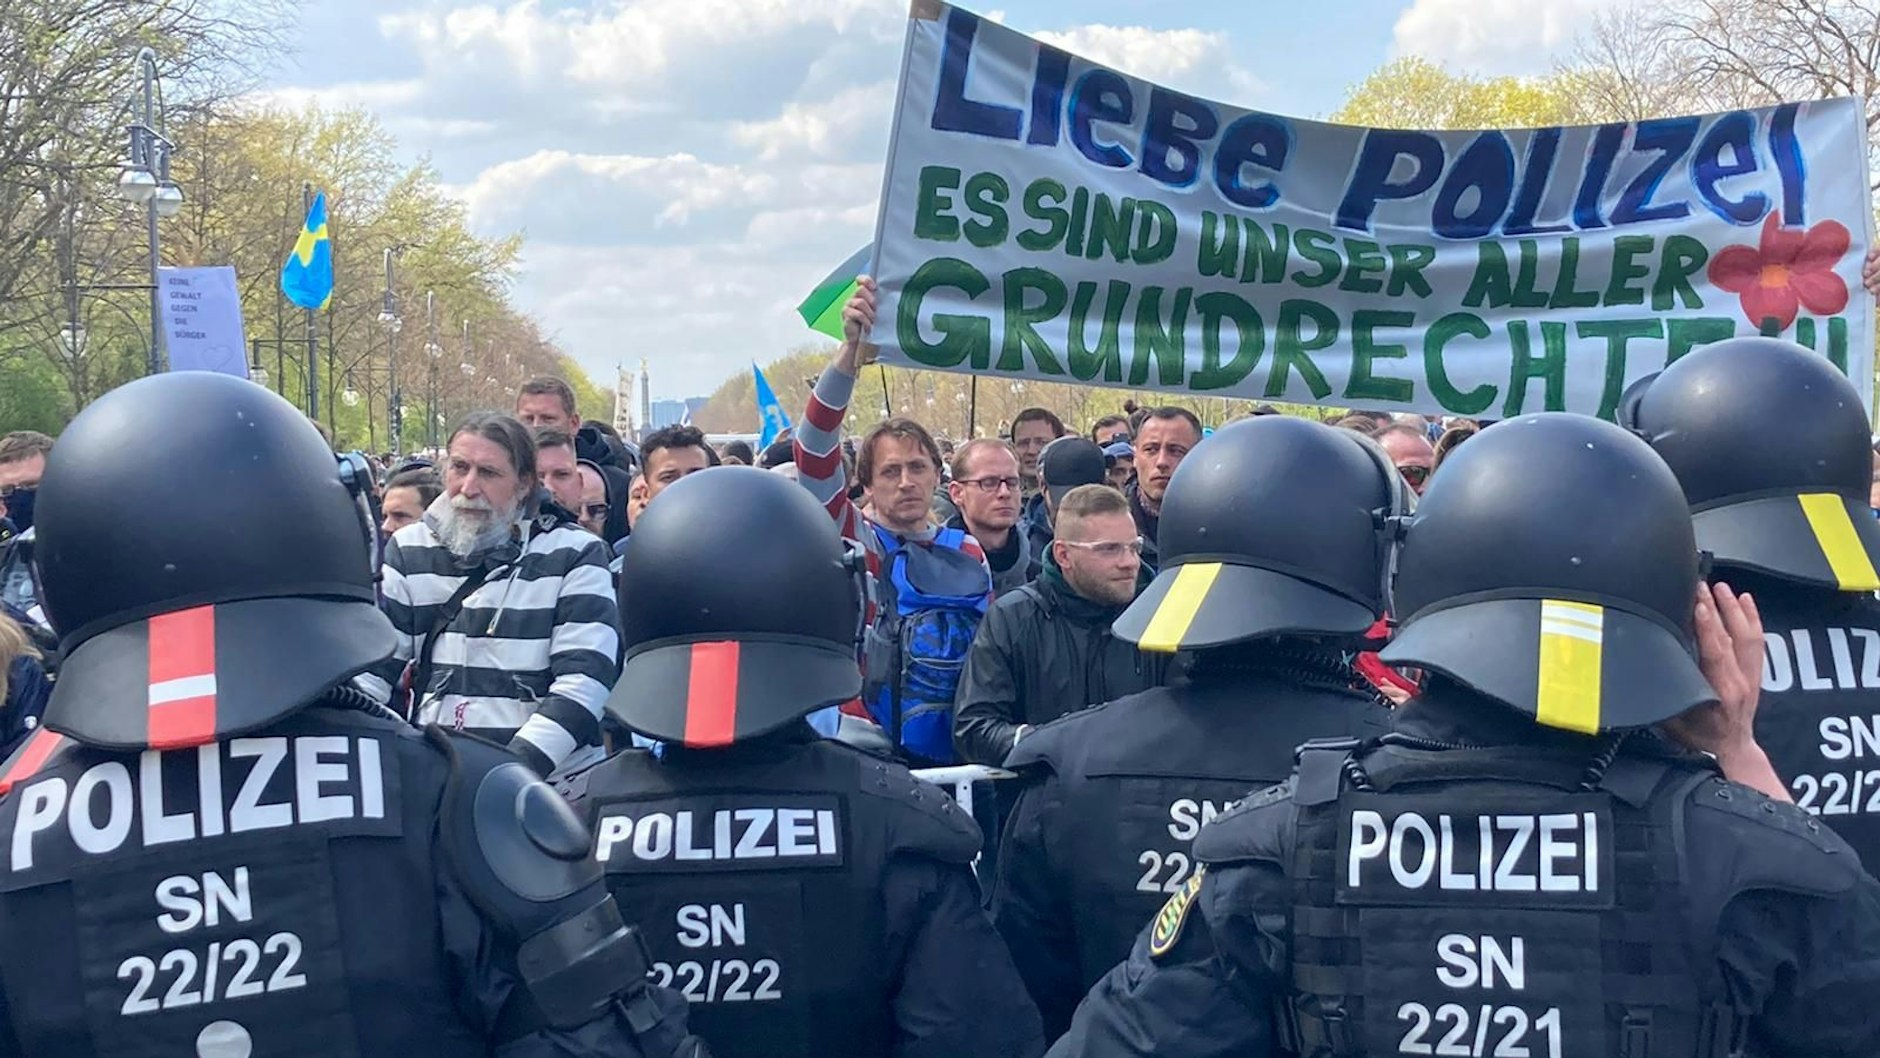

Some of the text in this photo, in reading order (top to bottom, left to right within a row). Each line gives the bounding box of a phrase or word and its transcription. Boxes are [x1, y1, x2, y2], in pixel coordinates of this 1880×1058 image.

[914, 165, 1708, 310] ES SIND UNSER ALLER
[11, 736, 384, 872] POLIZEI
[595, 808, 837, 862] POLIZEI
[1348, 810, 1598, 892] POLIZEI
[156, 865, 253, 933] SN
[676, 903, 745, 947] SN
[117, 931, 307, 1015] 22/22
[1436, 934, 1525, 989] SN
[1398, 1003, 1562, 1058] 22/21
